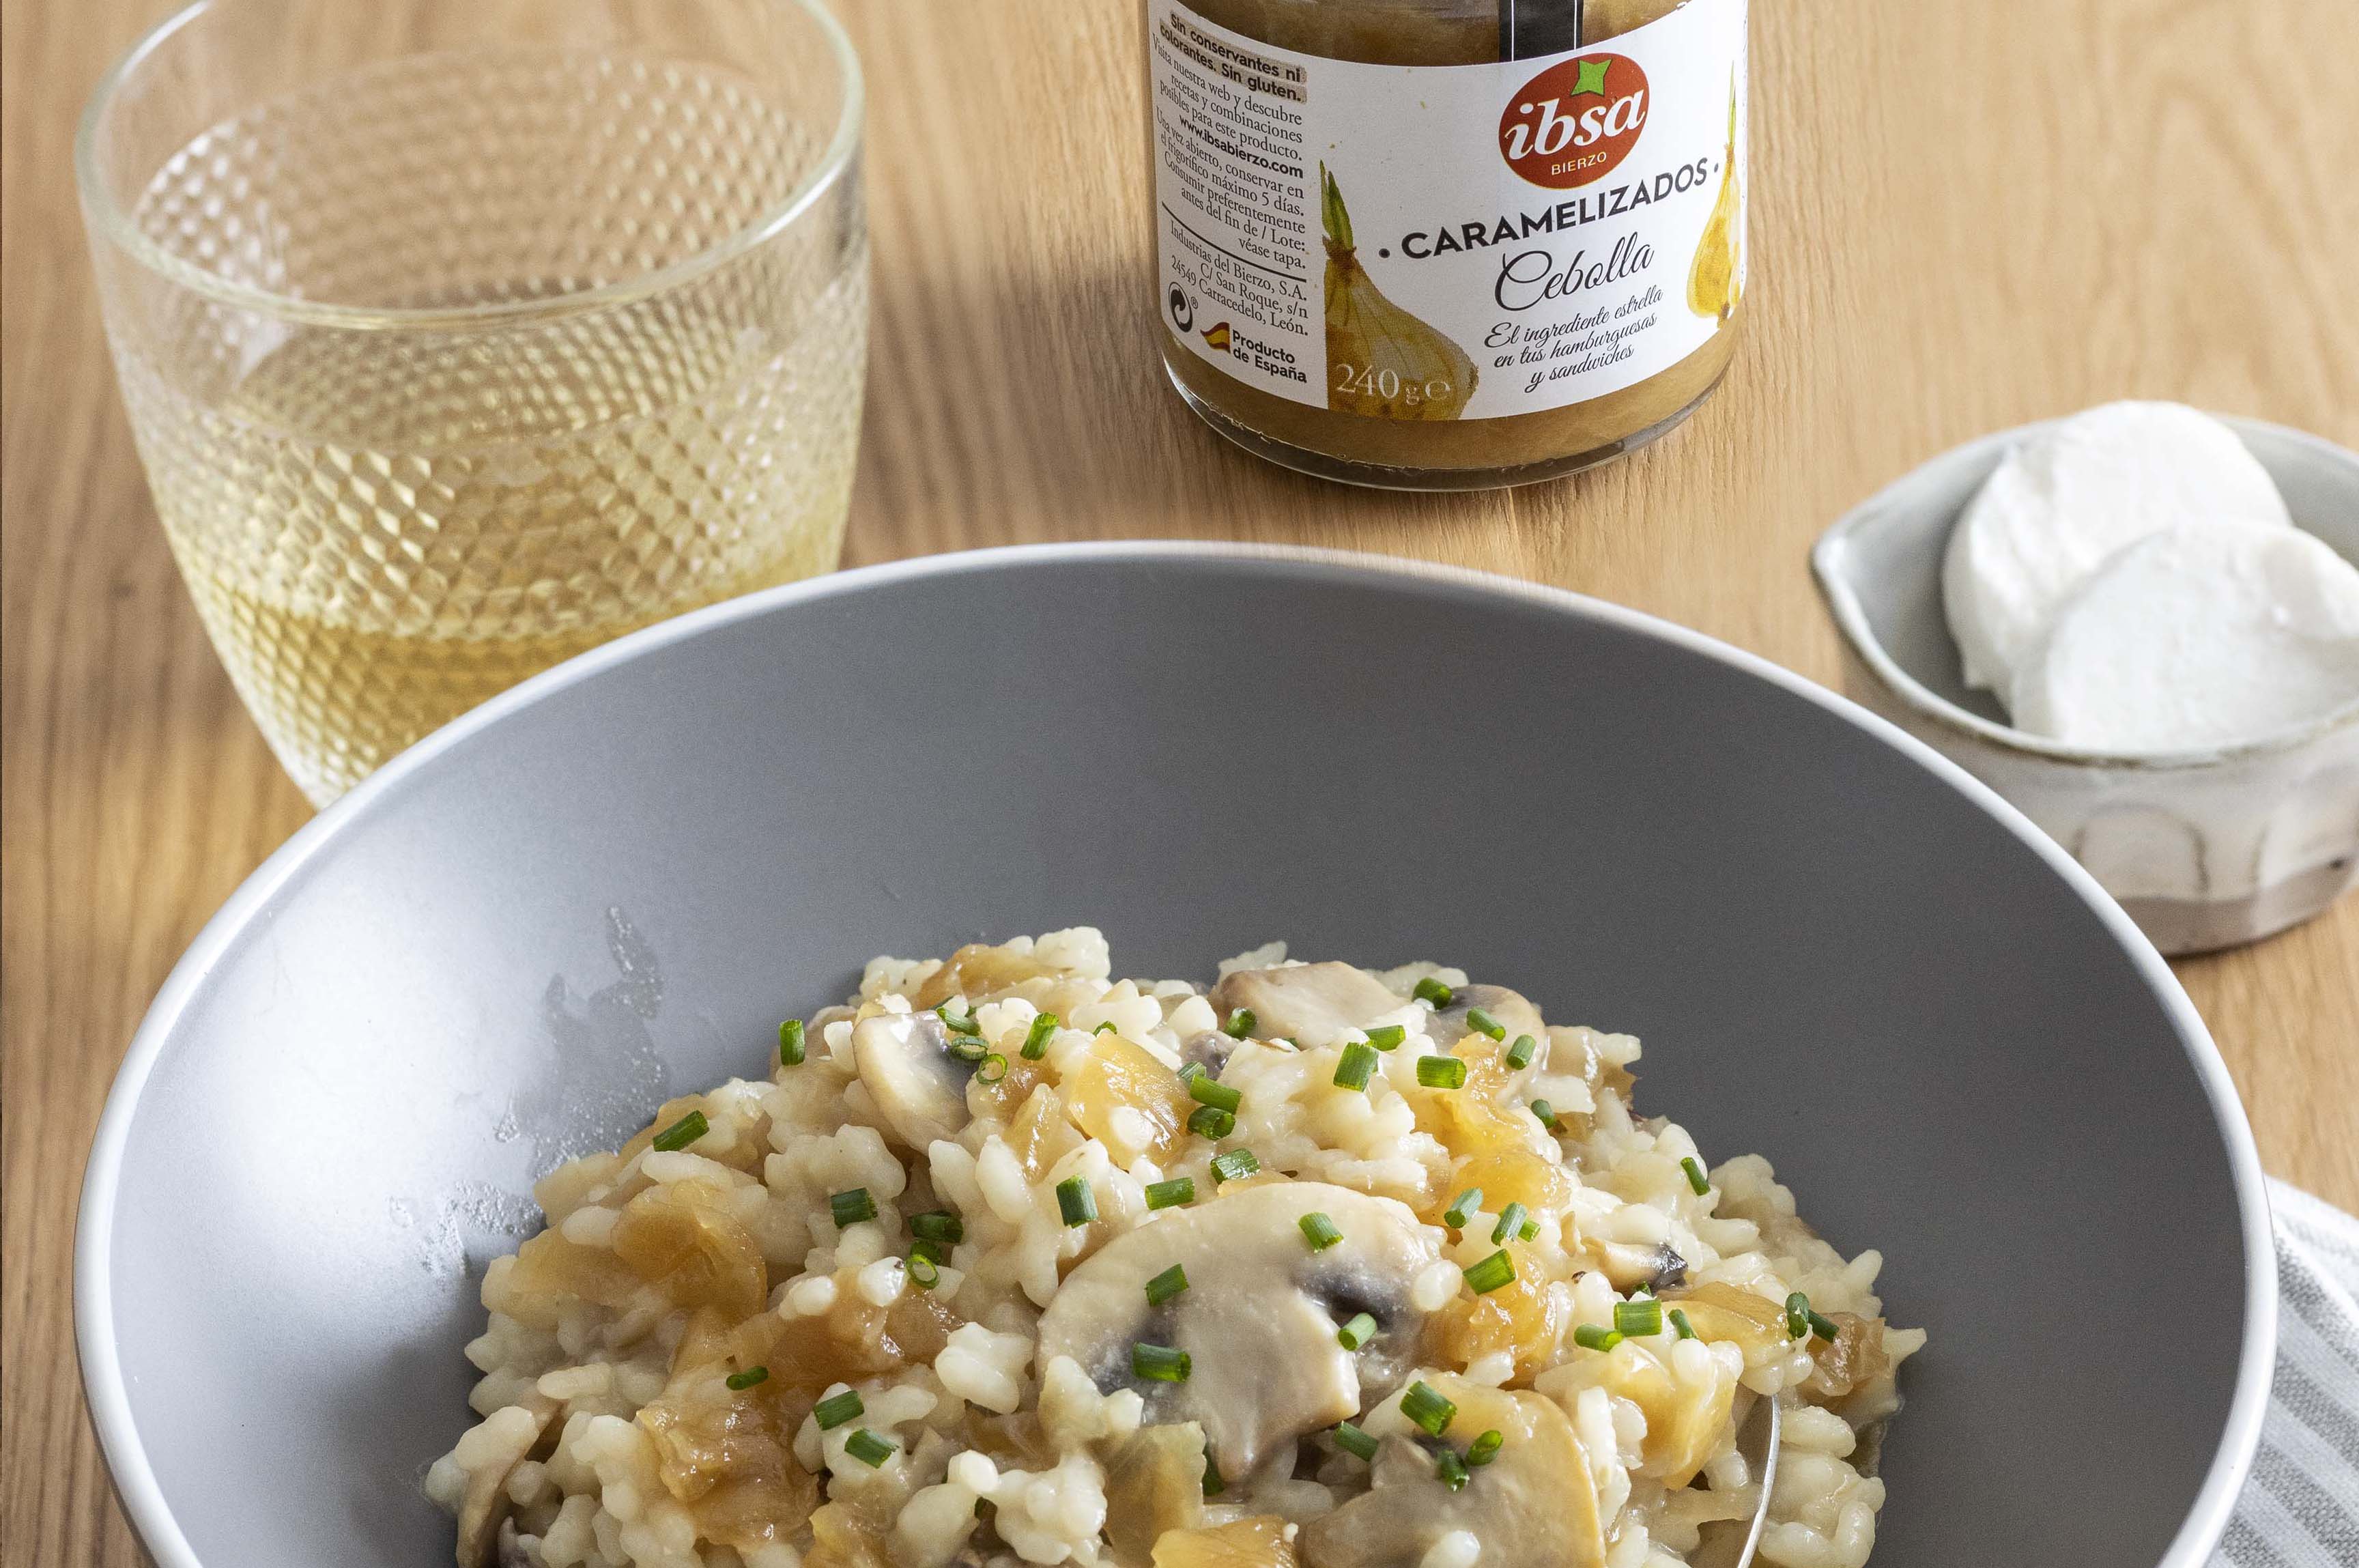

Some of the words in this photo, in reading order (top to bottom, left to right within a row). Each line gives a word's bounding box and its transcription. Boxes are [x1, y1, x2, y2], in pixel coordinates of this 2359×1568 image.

[1152, 33, 1172, 66] Visita
[1174, 60, 1206, 89] nuestra
[1208, 81, 1230, 101] web
[1234, 95, 1241, 108] y
[1245, 96, 1302, 125] descubre
[1160, 25, 1216, 71] colorantes.
[1222, 63, 1242, 83] Sin
[1248, 76, 1301, 102] gluten.
[1171, 14, 1186, 35] Sin
[1190, 31, 1279, 76] conservantes
[1286, 68, 1301, 82] ni
[1160, 79, 1189, 113] posibles
[1192, 107, 1212, 128] para
[1216, 122, 1236, 139] este
[1240, 132, 1302, 160] producto.
[1171, 75, 1199, 102] recetas
[1201, 96, 1207, 110] y
[1211, 102, 1302, 143] combinaciones
[1504, 87, 1646, 160] ibsa
[1157, 106, 1170, 133] Una
[1171, 127, 1184, 145] vez
[1186, 137, 1222, 171] abierto,
[1226, 164, 1283, 193] conservar
[1287, 186, 1304, 199] en
[1169, 137, 1208, 179] frigorífico
[1212, 173, 1257, 201] máximo
[1262, 192, 1269, 205] 5
[1274, 196, 1304, 216] días.
[1180, 115, 1303, 178] www.ibsabierzo.com
[1552, 151, 1607, 175] BIERZO
[1165, 151, 1205, 193] Consumir
[1208, 188, 1305, 233] preferentemente
[1182, 187, 1203, 210] antes
[1207, 201, 1221, 221] del
[1225, 210, 1240, 229] fin
[1244, 220, 1258, 236] de
[1271, 229, 1305, 251] Lote:
[1401, 157, 1708, 259] CARAMELIZADOS
[1171, 220, 1212, 263] Industrias
[1214, 253, 1230, 274] del
[1233, 263, 1274, 294] Bierzo,
[1280, 282, 1306, 300] S.A.
[1239, 238, 1270, 257] véase
[1274, 251, 1305, 270] tapa.
[1495, 231, 1655, 311] Cebolla
[1171, 255, 1196, 285] 24549
[1199, 278, 1266, 324] Carracedelo,
[1270, 312, 1308, 336] León.
[1201, 262, 1213, 280] C/
[1216, 272, 1235, 293] San
[1240, 283, 1283, 313] Roque,
[1287, 302, 1308, 318] s/n
[1484, 322, 1520, 347] El
[1524, 306, 1610, 348] ingrediente
[1614, 285, 1663, 319] estrella
[1233, 329, 1295, 364] Producto
[1233, 347, 1249, 362] de
[1255, 355, 1306, 383] España
[1494, 354, 1514, 368] en
[1520, 346, 1546, 364] tus
[1550, 313, 1657, 359] hamburguesas
[1524, 372, 1545, 393] y
[1549, 343, 1634, 380] sandwiches
